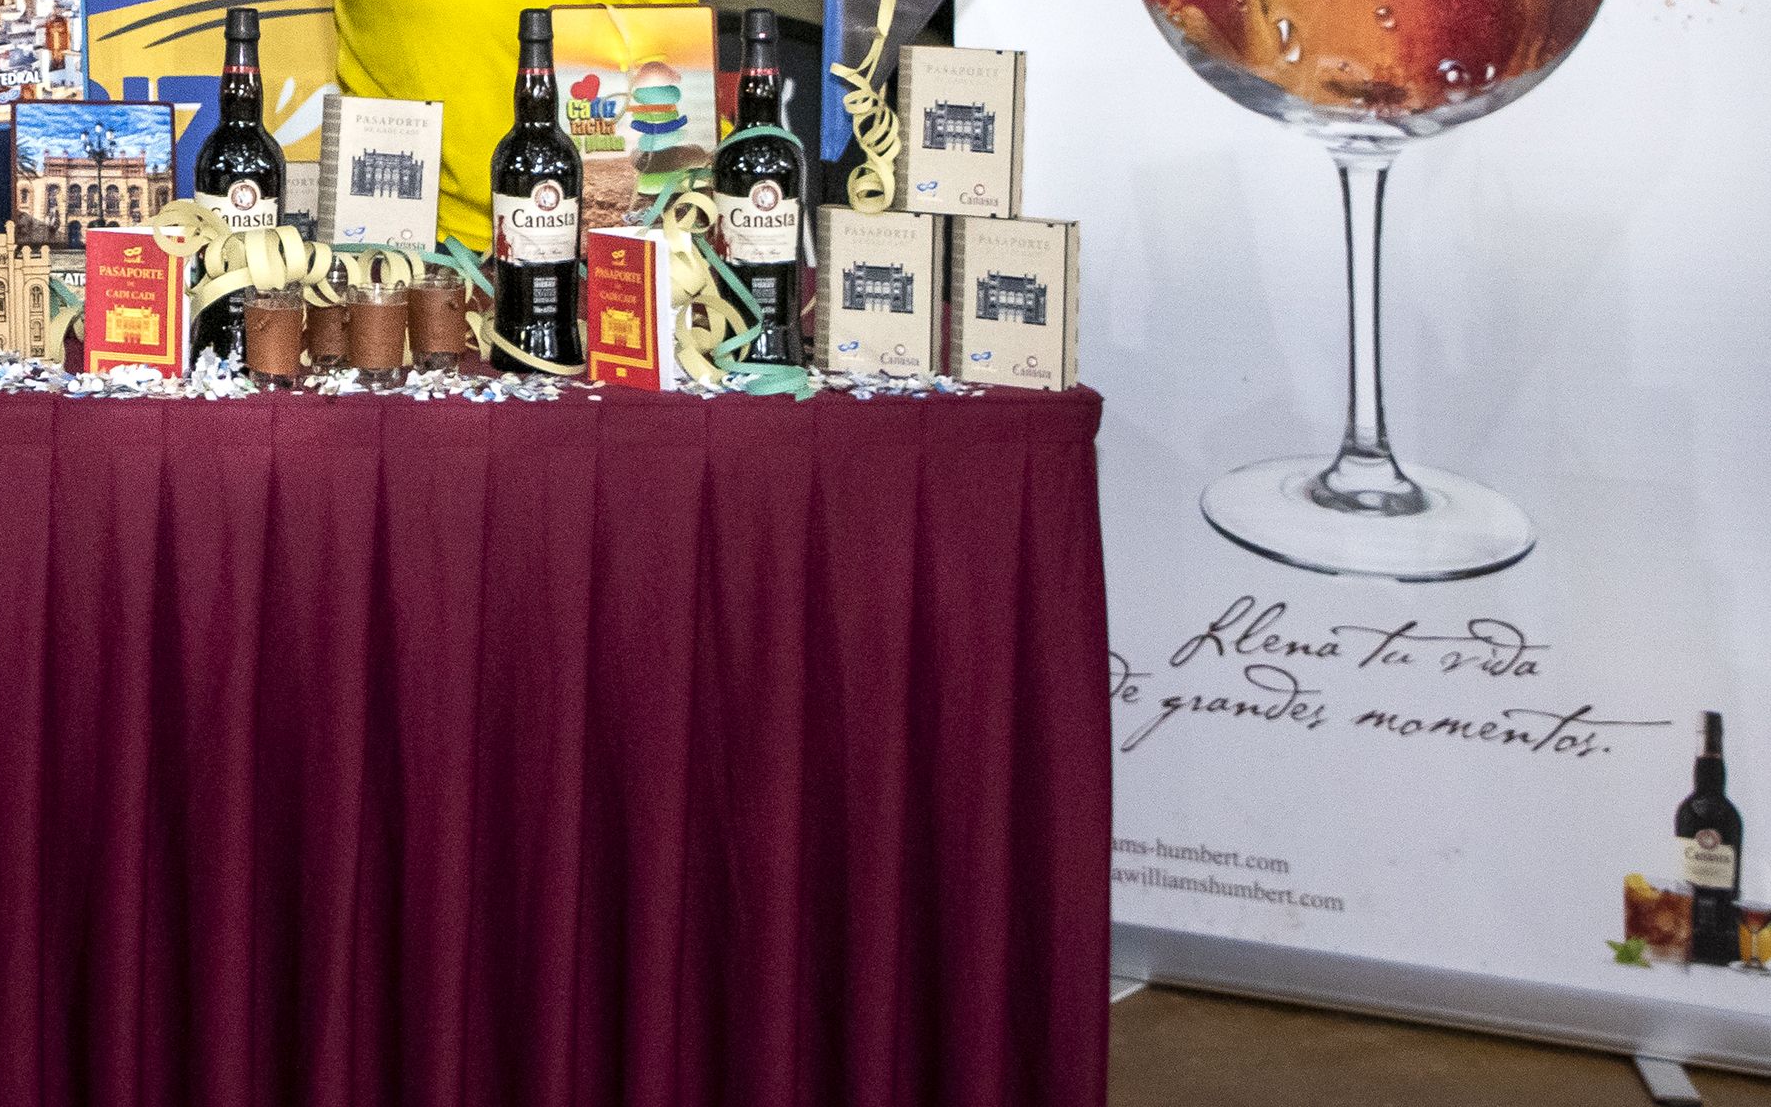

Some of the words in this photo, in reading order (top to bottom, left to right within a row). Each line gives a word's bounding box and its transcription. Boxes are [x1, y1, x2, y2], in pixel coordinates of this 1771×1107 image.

[355, 114, 429, 128] PASAPORTE
[511, 208, 575, 228] Canasta
[730, 207, 795, 228] Canasta
[99, 265, 165, 280] PASAPORTE
[1440, 618, 1551, 678] vida
[1120, 663, 1327, 754] grandes
[1112, 837, 1290, 874] ams-humbert.com
[1110, 866, 1345, 913] awilliamshumbert.com
